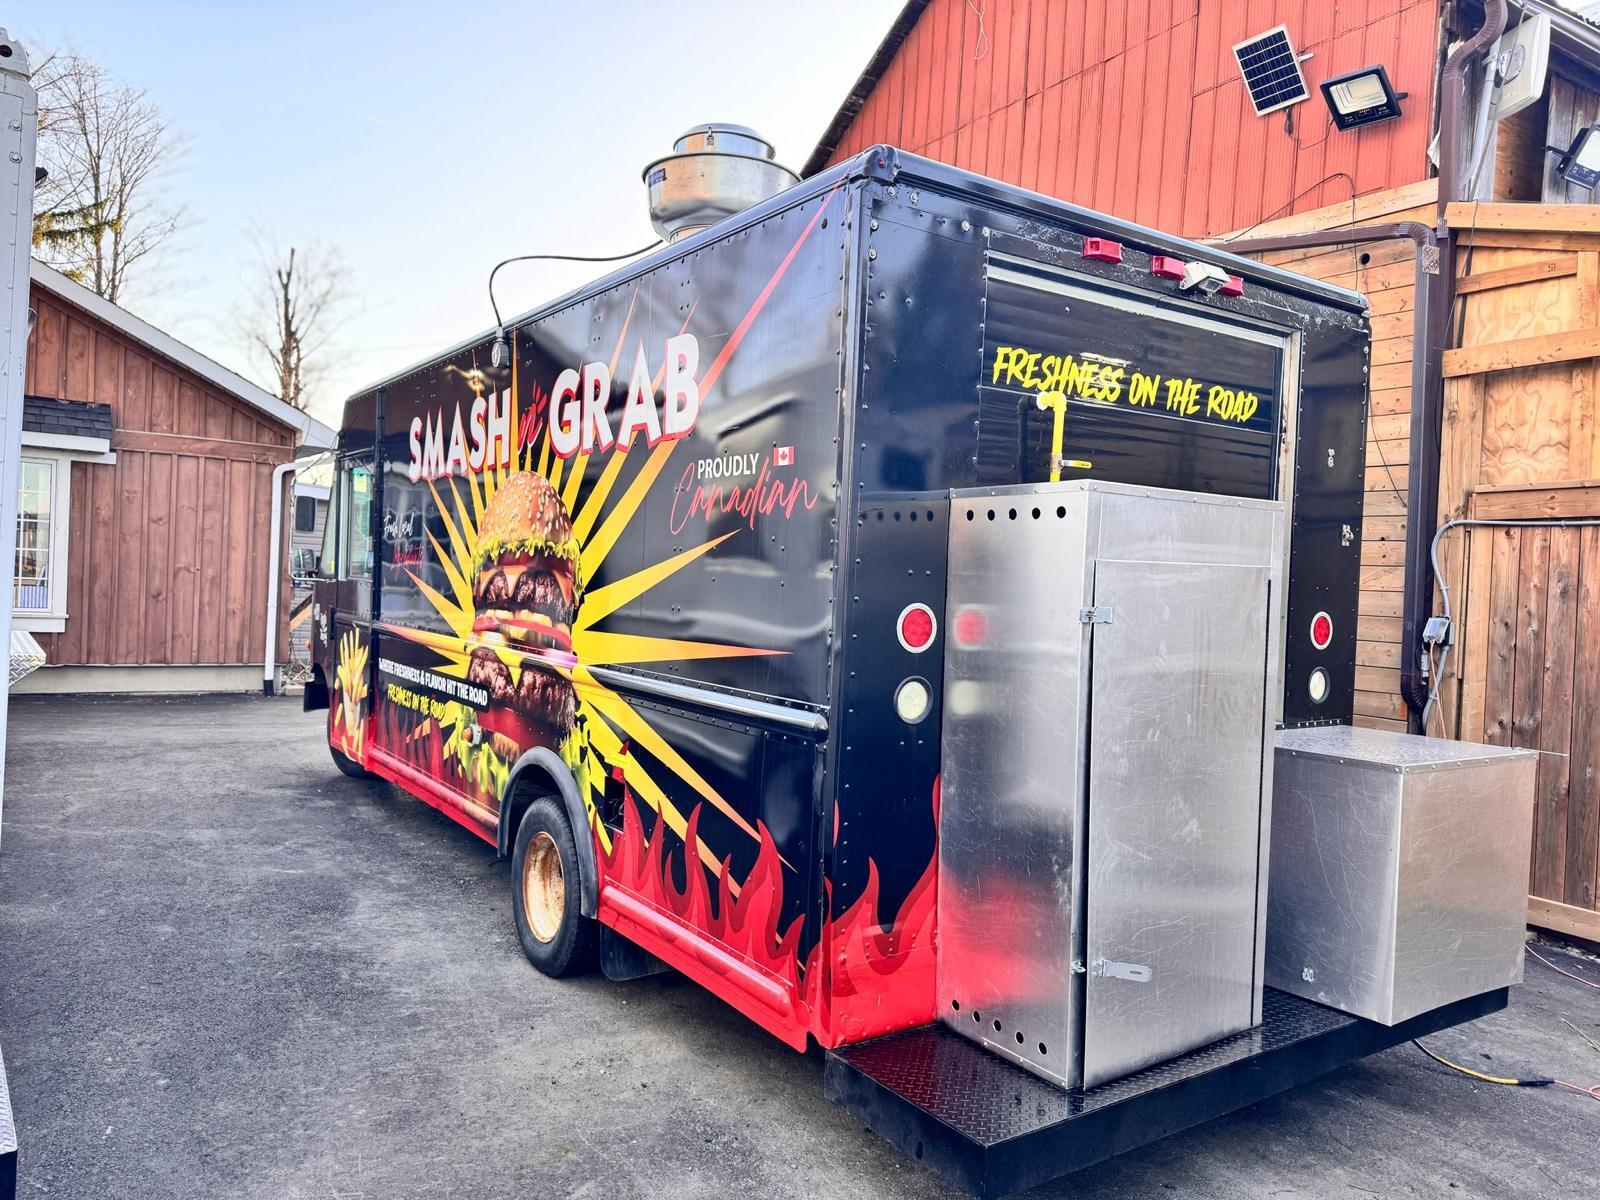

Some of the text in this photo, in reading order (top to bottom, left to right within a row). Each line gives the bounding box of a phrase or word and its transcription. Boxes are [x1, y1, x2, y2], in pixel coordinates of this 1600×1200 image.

[408, 387, 512, 484] SMASH
[549, 333, 700, 460] GRAB
[993, 346, 1258, 423] FRESHNESS ON THE ROAD
[670, 456, 819, 535] Canadian
[697, 453, 760, 480] PROUDLY
[394, 662, 420, 683] FRESHNESS
[425, 672, 447, 692] FLAVOR
[447, 678, 457, 696] HIT
[457, 682, 469, 700] THE
[469, 685, 488, 706] ROAD
